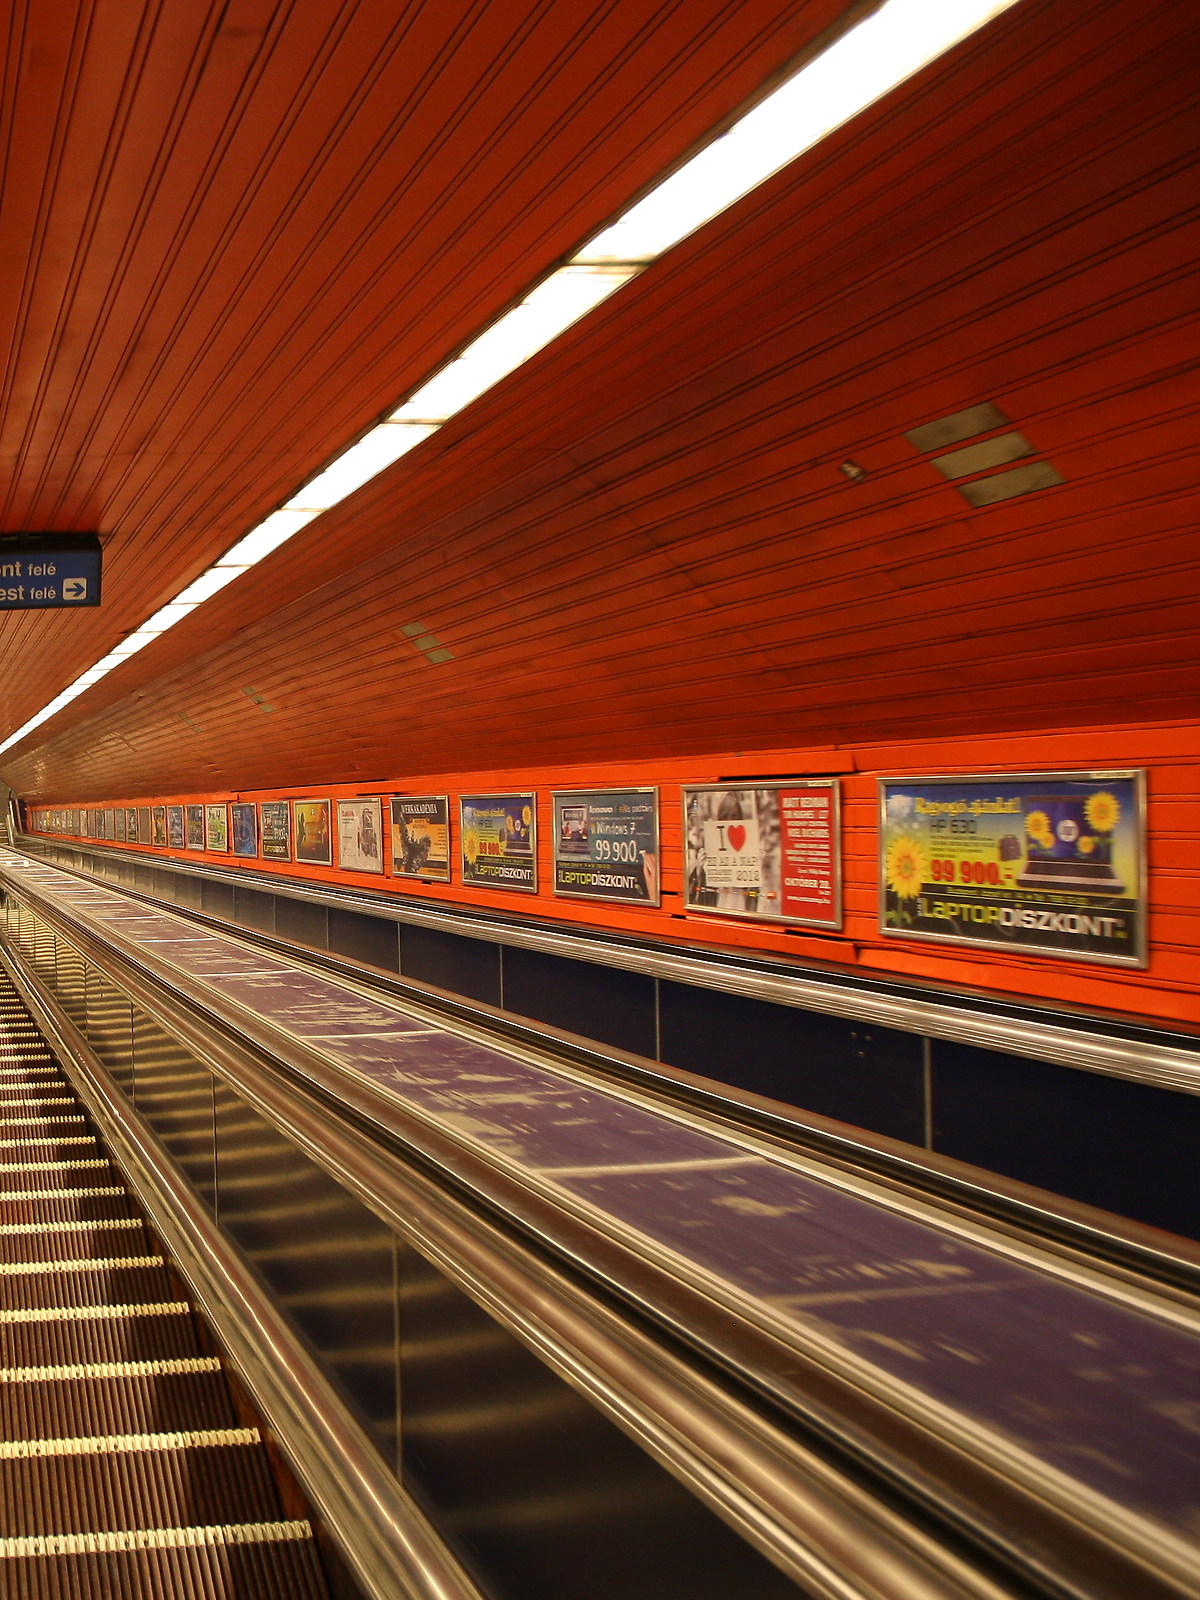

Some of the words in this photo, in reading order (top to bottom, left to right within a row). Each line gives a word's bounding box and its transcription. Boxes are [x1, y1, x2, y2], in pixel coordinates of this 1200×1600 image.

[28, 563, 56, 577] felé
[29, 586, 56, 600] felé
[596, 822, 628, 835] Windows
[629, 822, 636, 835] 7
[716, 825, 727, 851] I
[596, 840, 611, 860] 99
[736, 870, 760, 881] 2012
[931, 859, 955, 882] 99
